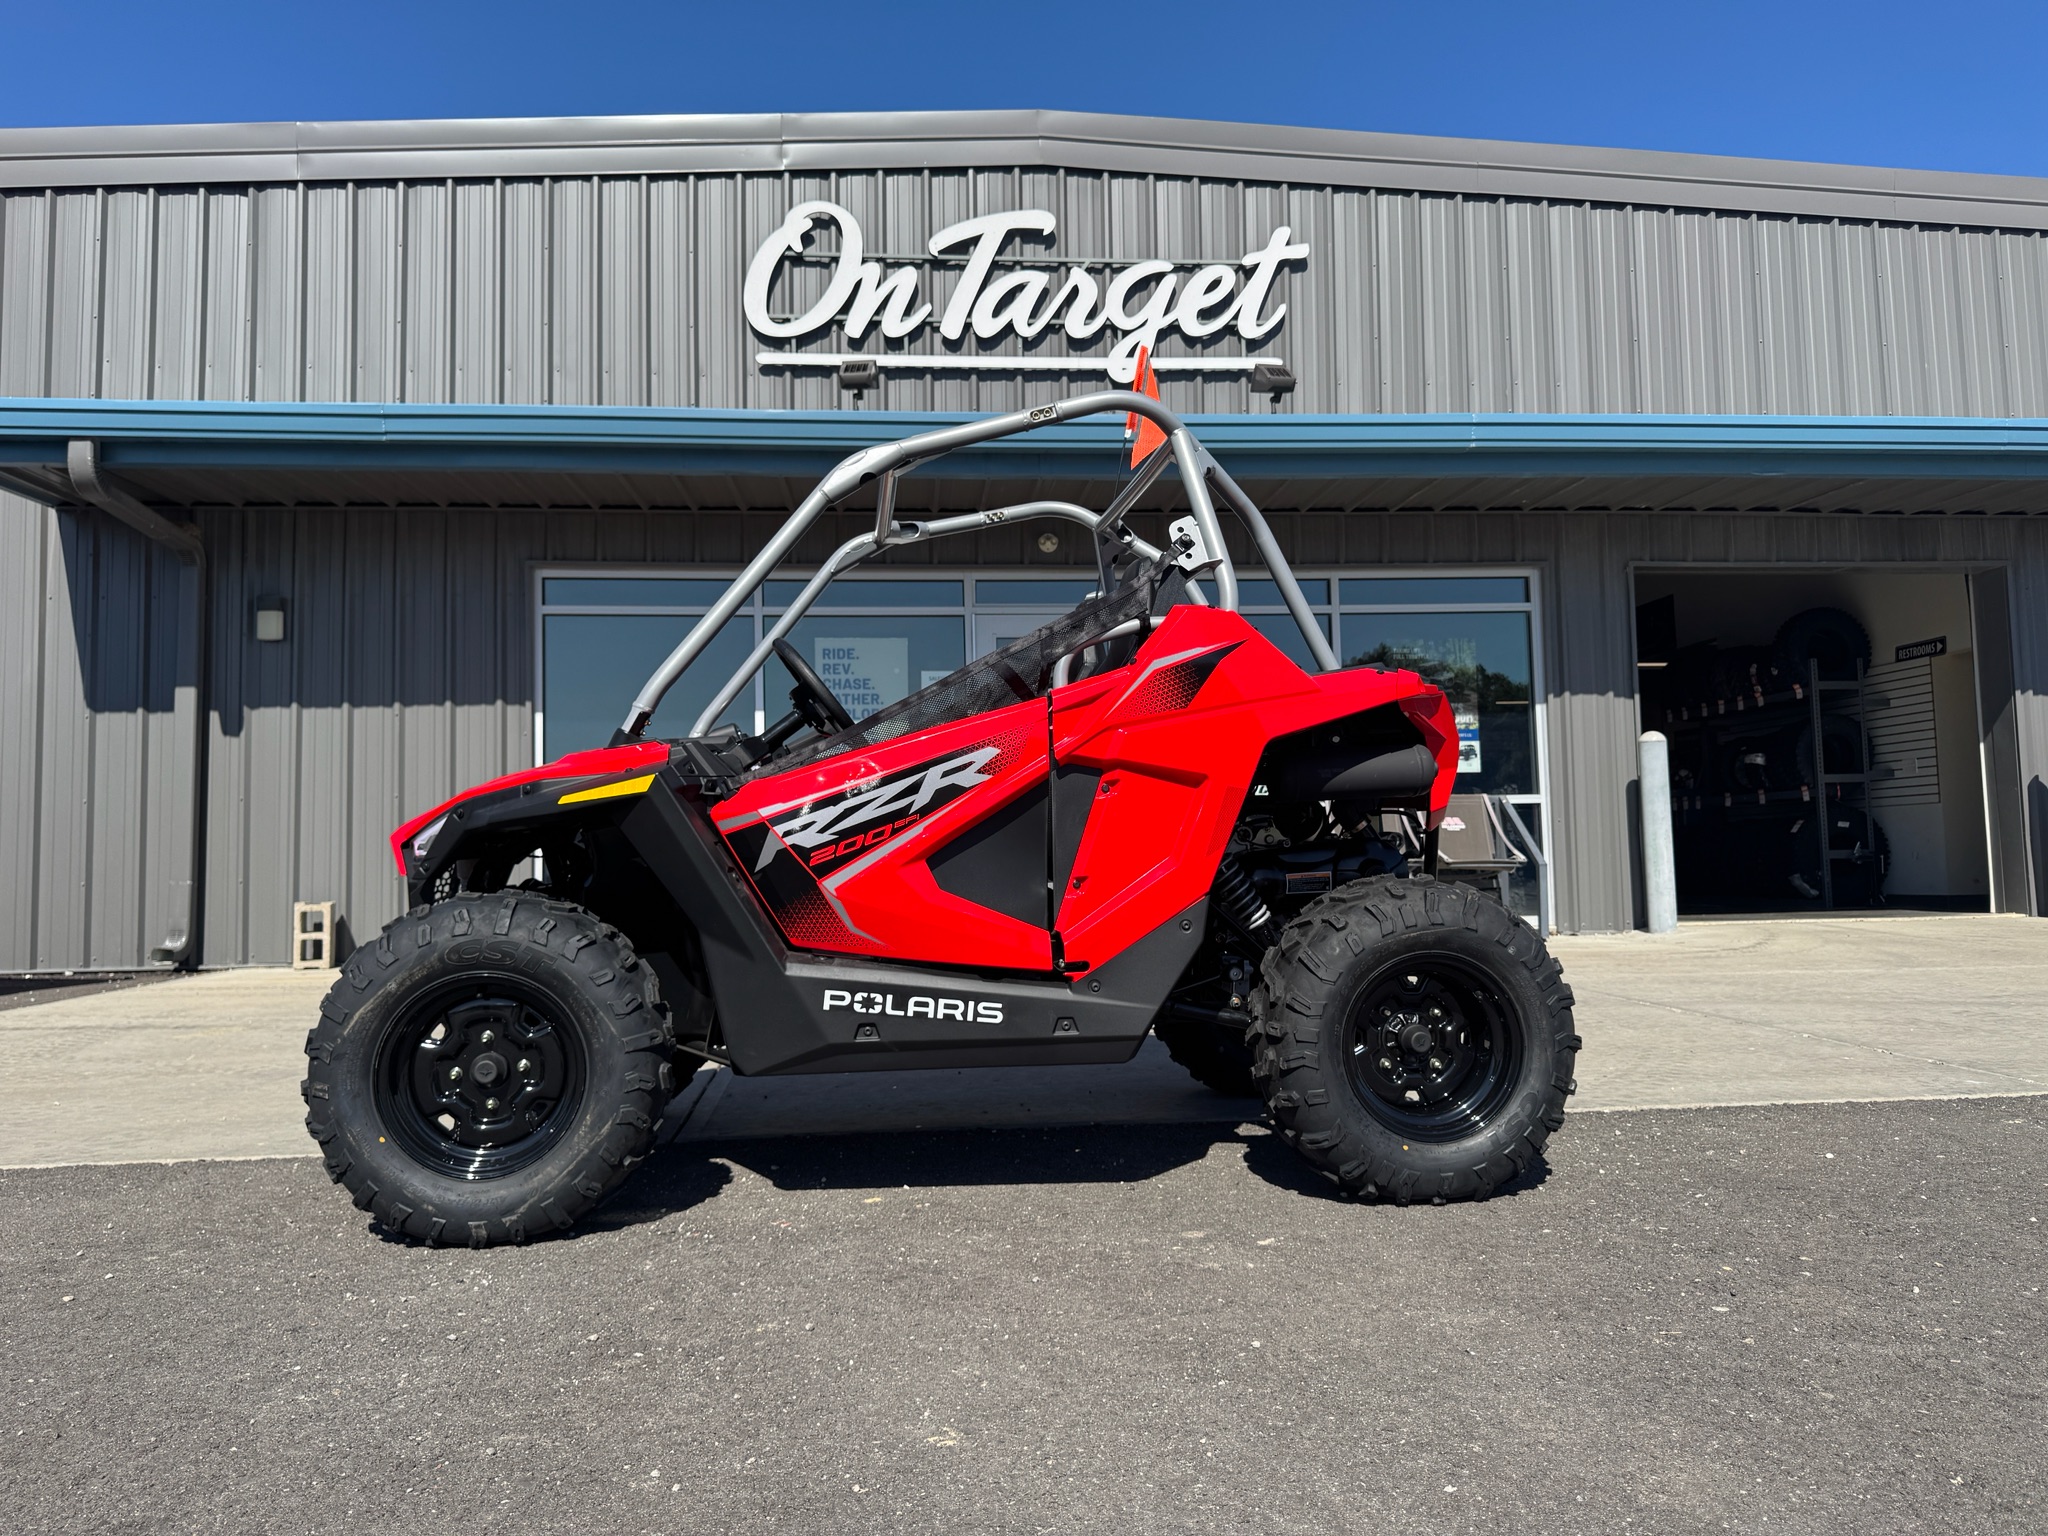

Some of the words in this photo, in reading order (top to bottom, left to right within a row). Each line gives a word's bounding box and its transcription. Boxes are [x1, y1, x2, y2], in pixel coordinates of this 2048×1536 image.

[743, 200, 932, 339] On
[928, 209, 1310, 383] Target
[822, 648, 860, 660] RIDE.
[1898, 643, 1936, 660] RESTROOMS
[822, 663, 855, 675] REV.
[823, 678, 876, 690] CHASE.
[835, 693, 885, 705] ATHER.
[754, 746, 1001, 874] RZR
[809, 824, 893, 867] 200
[894, 813, 920, 829] EFI
[443, 937, 559, 974] CST
[822, 989, 1004, 1024] POLARIS
